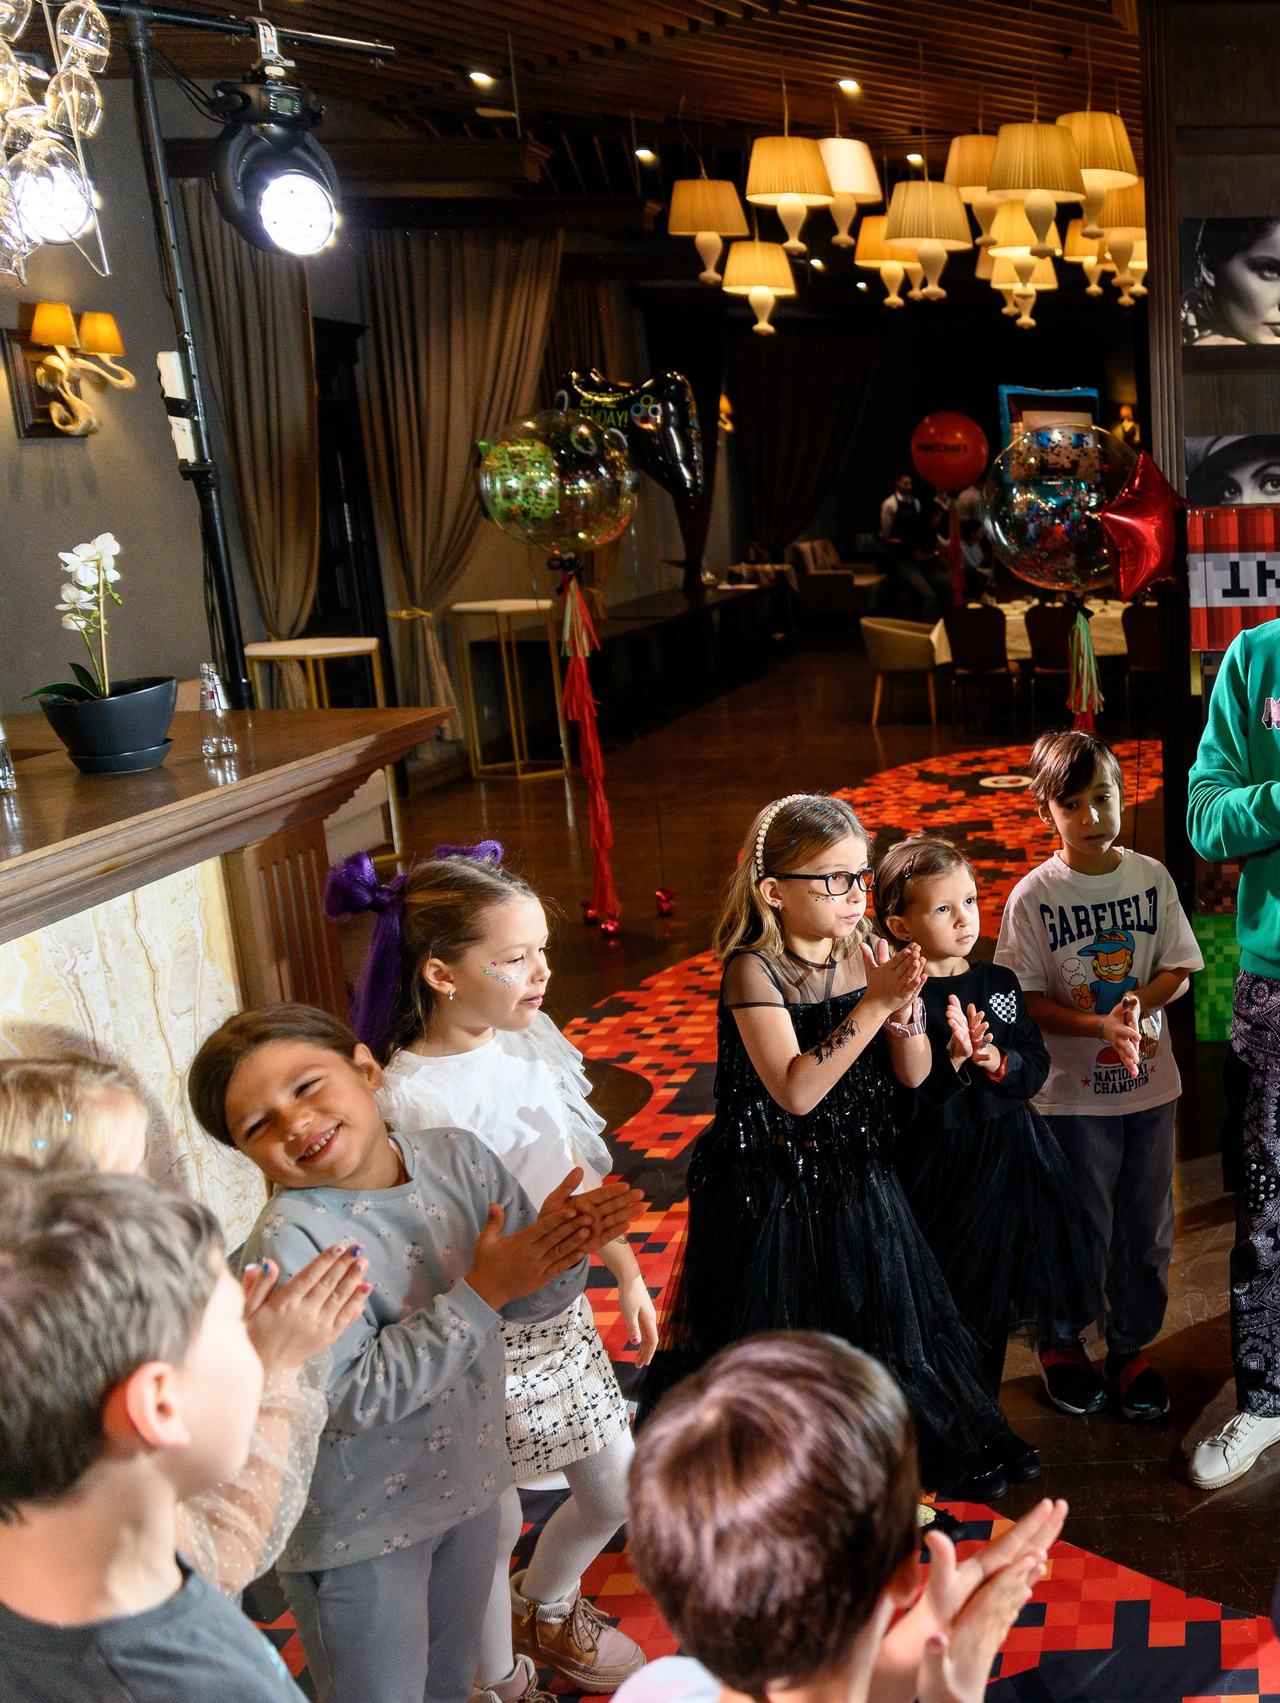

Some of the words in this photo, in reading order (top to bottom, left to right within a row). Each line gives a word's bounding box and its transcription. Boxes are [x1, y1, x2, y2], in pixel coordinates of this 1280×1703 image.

[1039, 886, 1157, 952] GARFIELD
[1093, 1063, 1149, 1082] NATIOAL
[1093, 1073, 1149, 1094] CHAMPION
